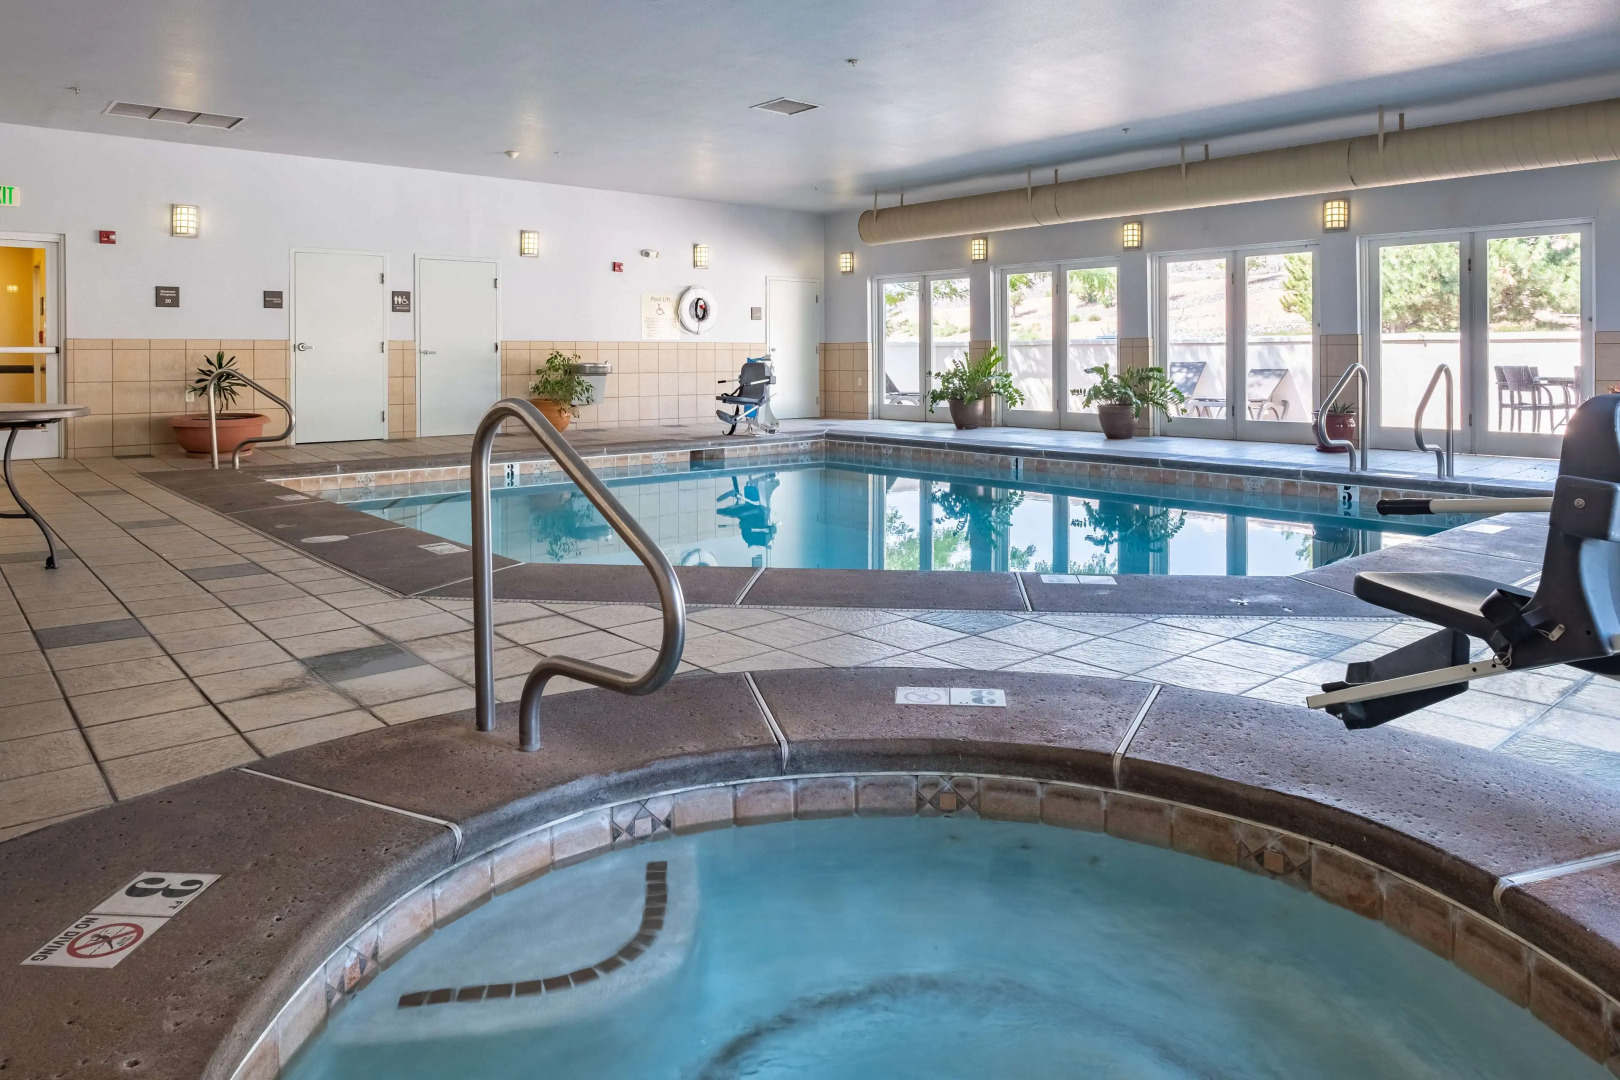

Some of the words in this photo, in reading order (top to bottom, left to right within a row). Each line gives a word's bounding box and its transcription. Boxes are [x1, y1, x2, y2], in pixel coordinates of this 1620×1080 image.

[0, 186, 14, 205] IT
[124, 877, 204, 898] 3
[168, 900, 184, 910] FT
[74, 917, 99, 929] NO
[30, 931, 81, 962] DIVING
